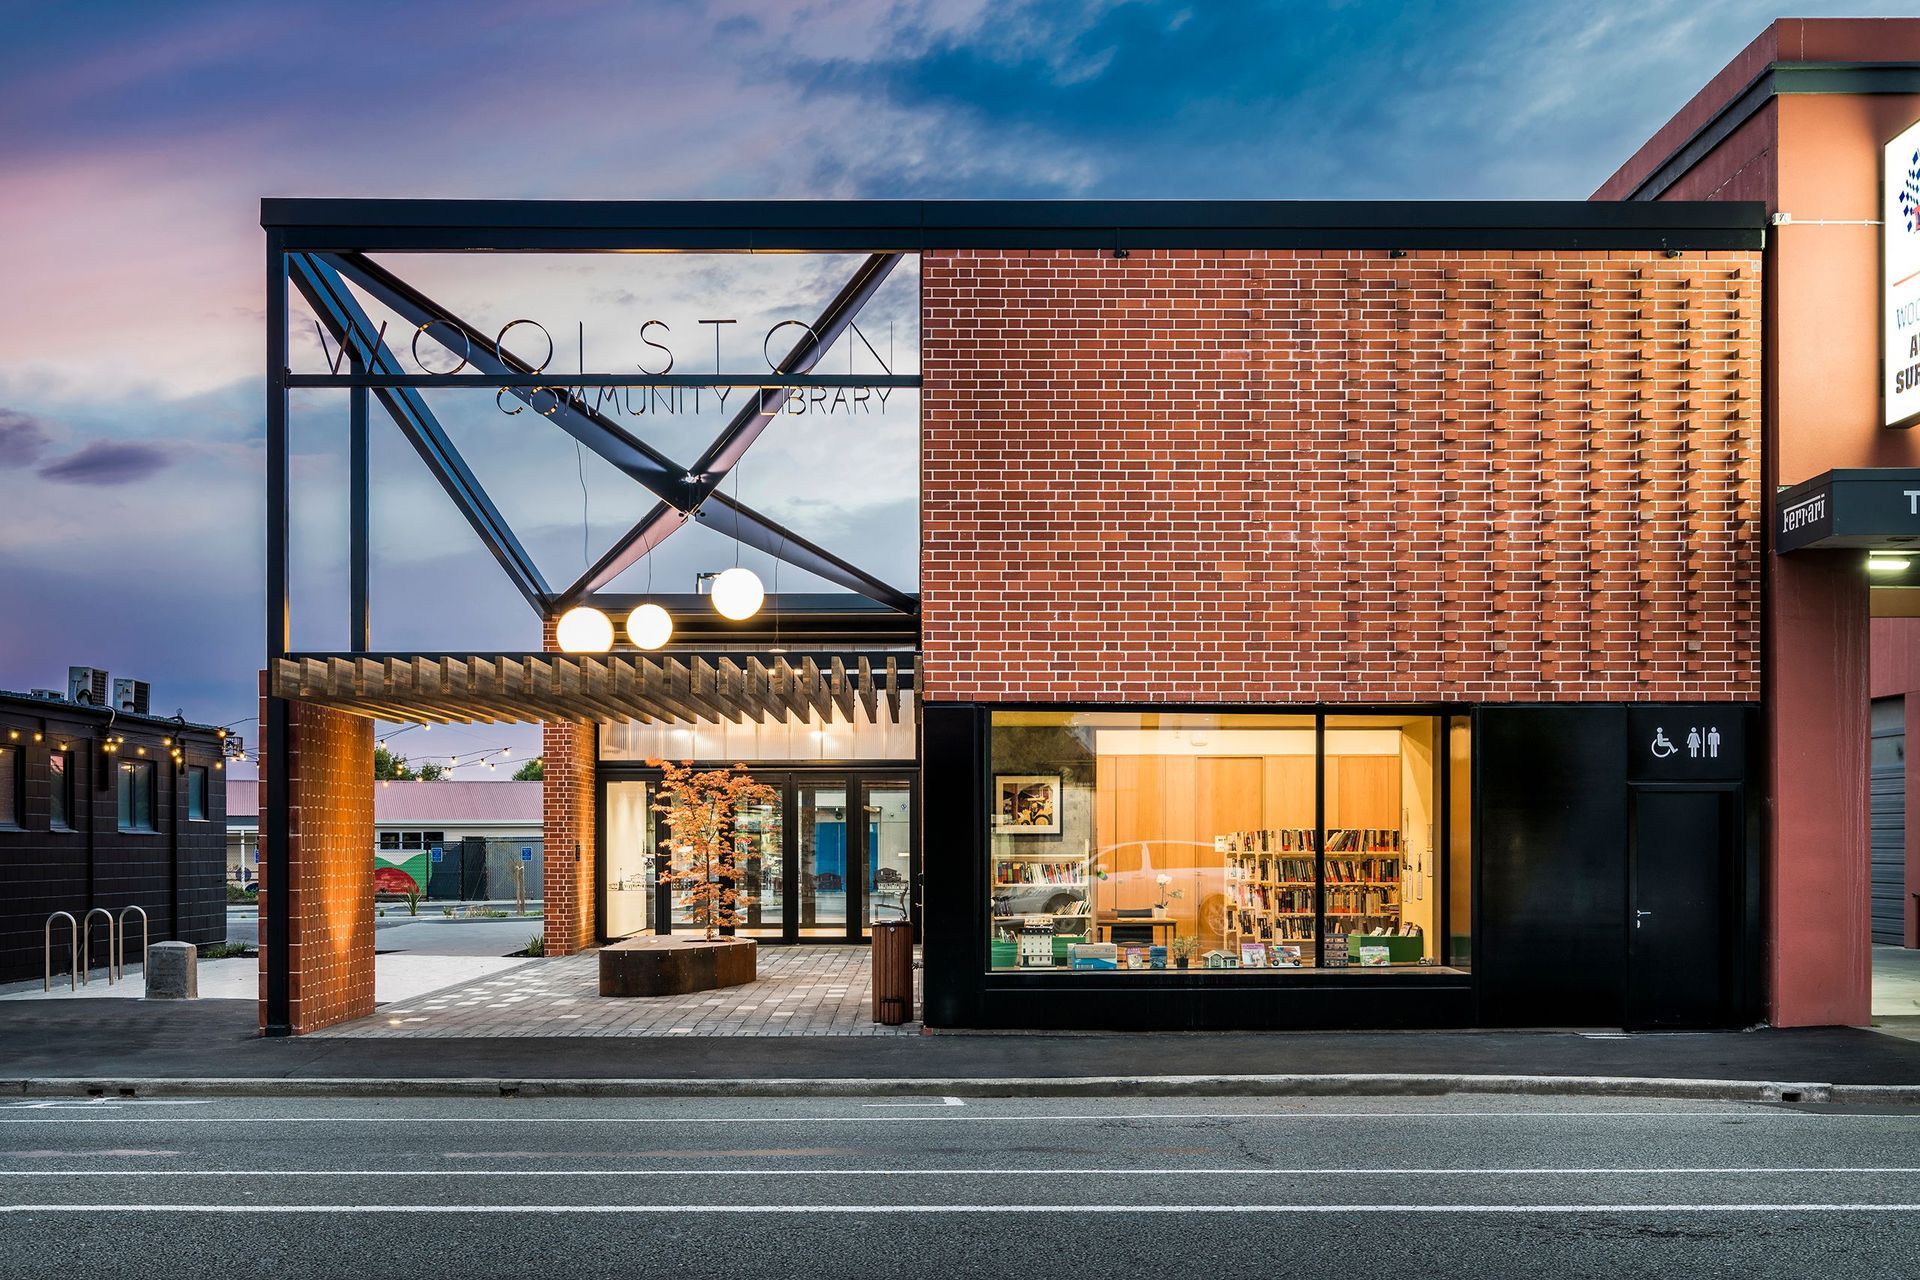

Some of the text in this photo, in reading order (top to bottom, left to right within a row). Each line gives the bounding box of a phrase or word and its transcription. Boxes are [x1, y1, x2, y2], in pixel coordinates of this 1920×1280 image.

[314, 319, 893, 375] WOOLSTON
[1909, 331, 1920, 359] A
[496, 385, 892, 416] COMMUNITY LIBRARY
[1782, 493, 1825, 533] Ferrari
